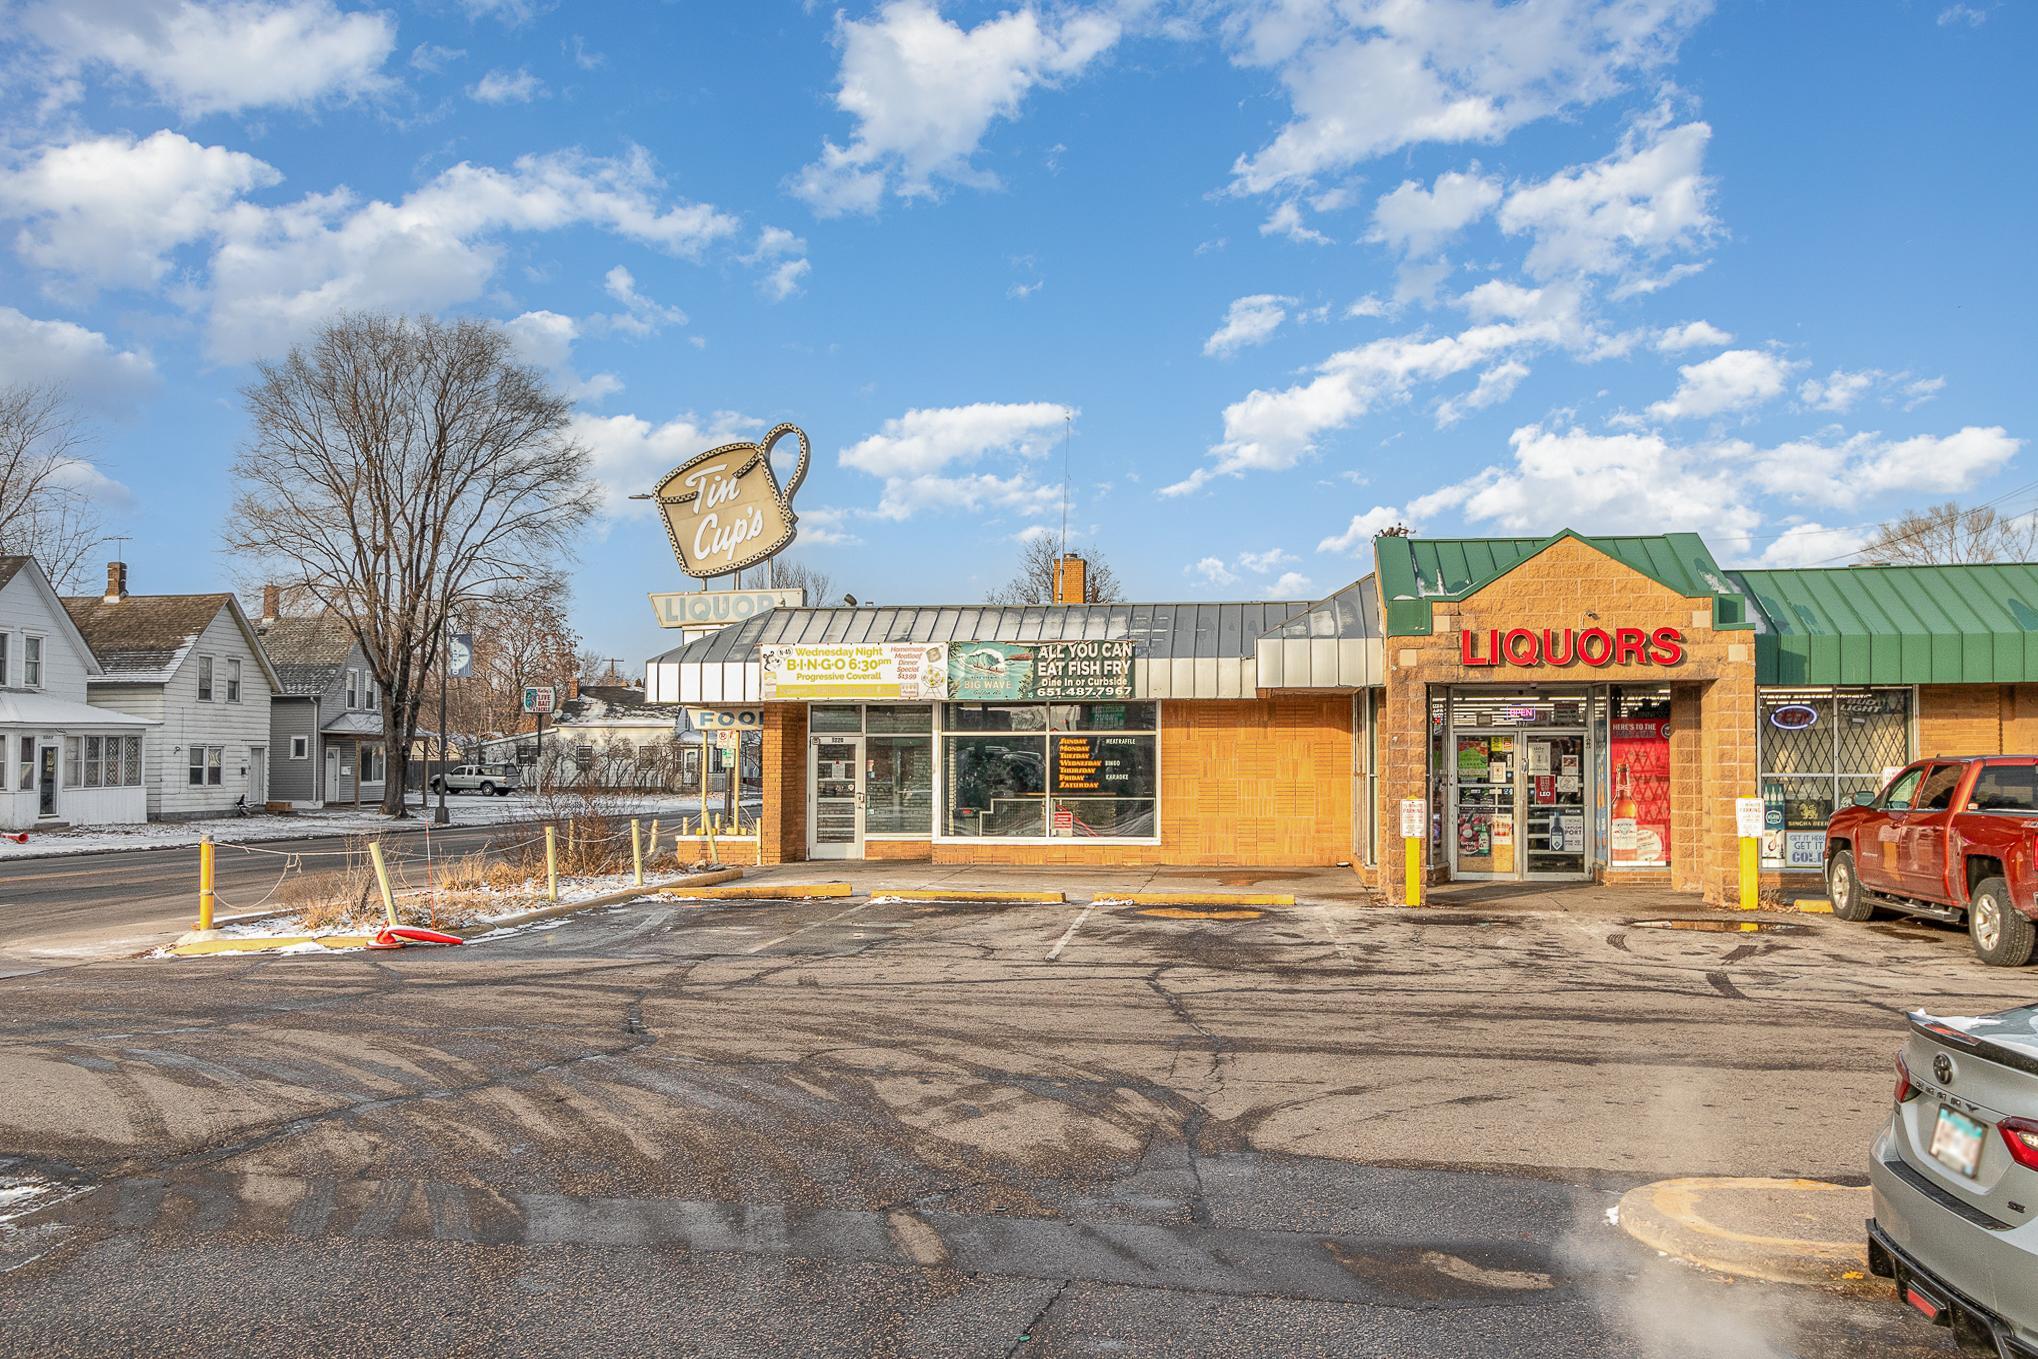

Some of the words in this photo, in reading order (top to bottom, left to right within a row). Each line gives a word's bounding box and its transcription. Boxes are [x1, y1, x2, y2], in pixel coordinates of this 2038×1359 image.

[684, 464, 741, 514] Tin
[693, 506, 764, 561] Cup's
[1038, 644, 1065, 659] ALL
[1070, 643, 1099, 658] YOU
[1102, 642, 1133, 657] CAN
[1462, 626, 1683, 667] LIQUORS
[795, 647, 853, 659] Wednesday
[855, 647, 883, 659] Night
[1037, 661, 1066, 677] EAT
[1069, 660, 1101, 676] FISH
[1103, 660, 1132, 676] FRY
[796, 673, 845, 682] Progressive
[846, 672, 881, 681] Coverall
[1041, 678, 1062, 687] Dine
[1064, 678, 1073, 687] In
[1075, 679, 1085, 687] or
[1087, 677, 1127, 687] Curbside
[964, 681, 981, 689] BIG
[984, 681, 1012, 689] WAVE
[1037, 686, 1133, 697] 651.487.7967
[1510, 708, 1533, 717] OPEN
[1840, 704, 1882, 713] LIGHT
[1644, 723, 1656, 731] THE
[1794, 841, 1812, 850] GET
[1815, 841, 1824, 850] IT
